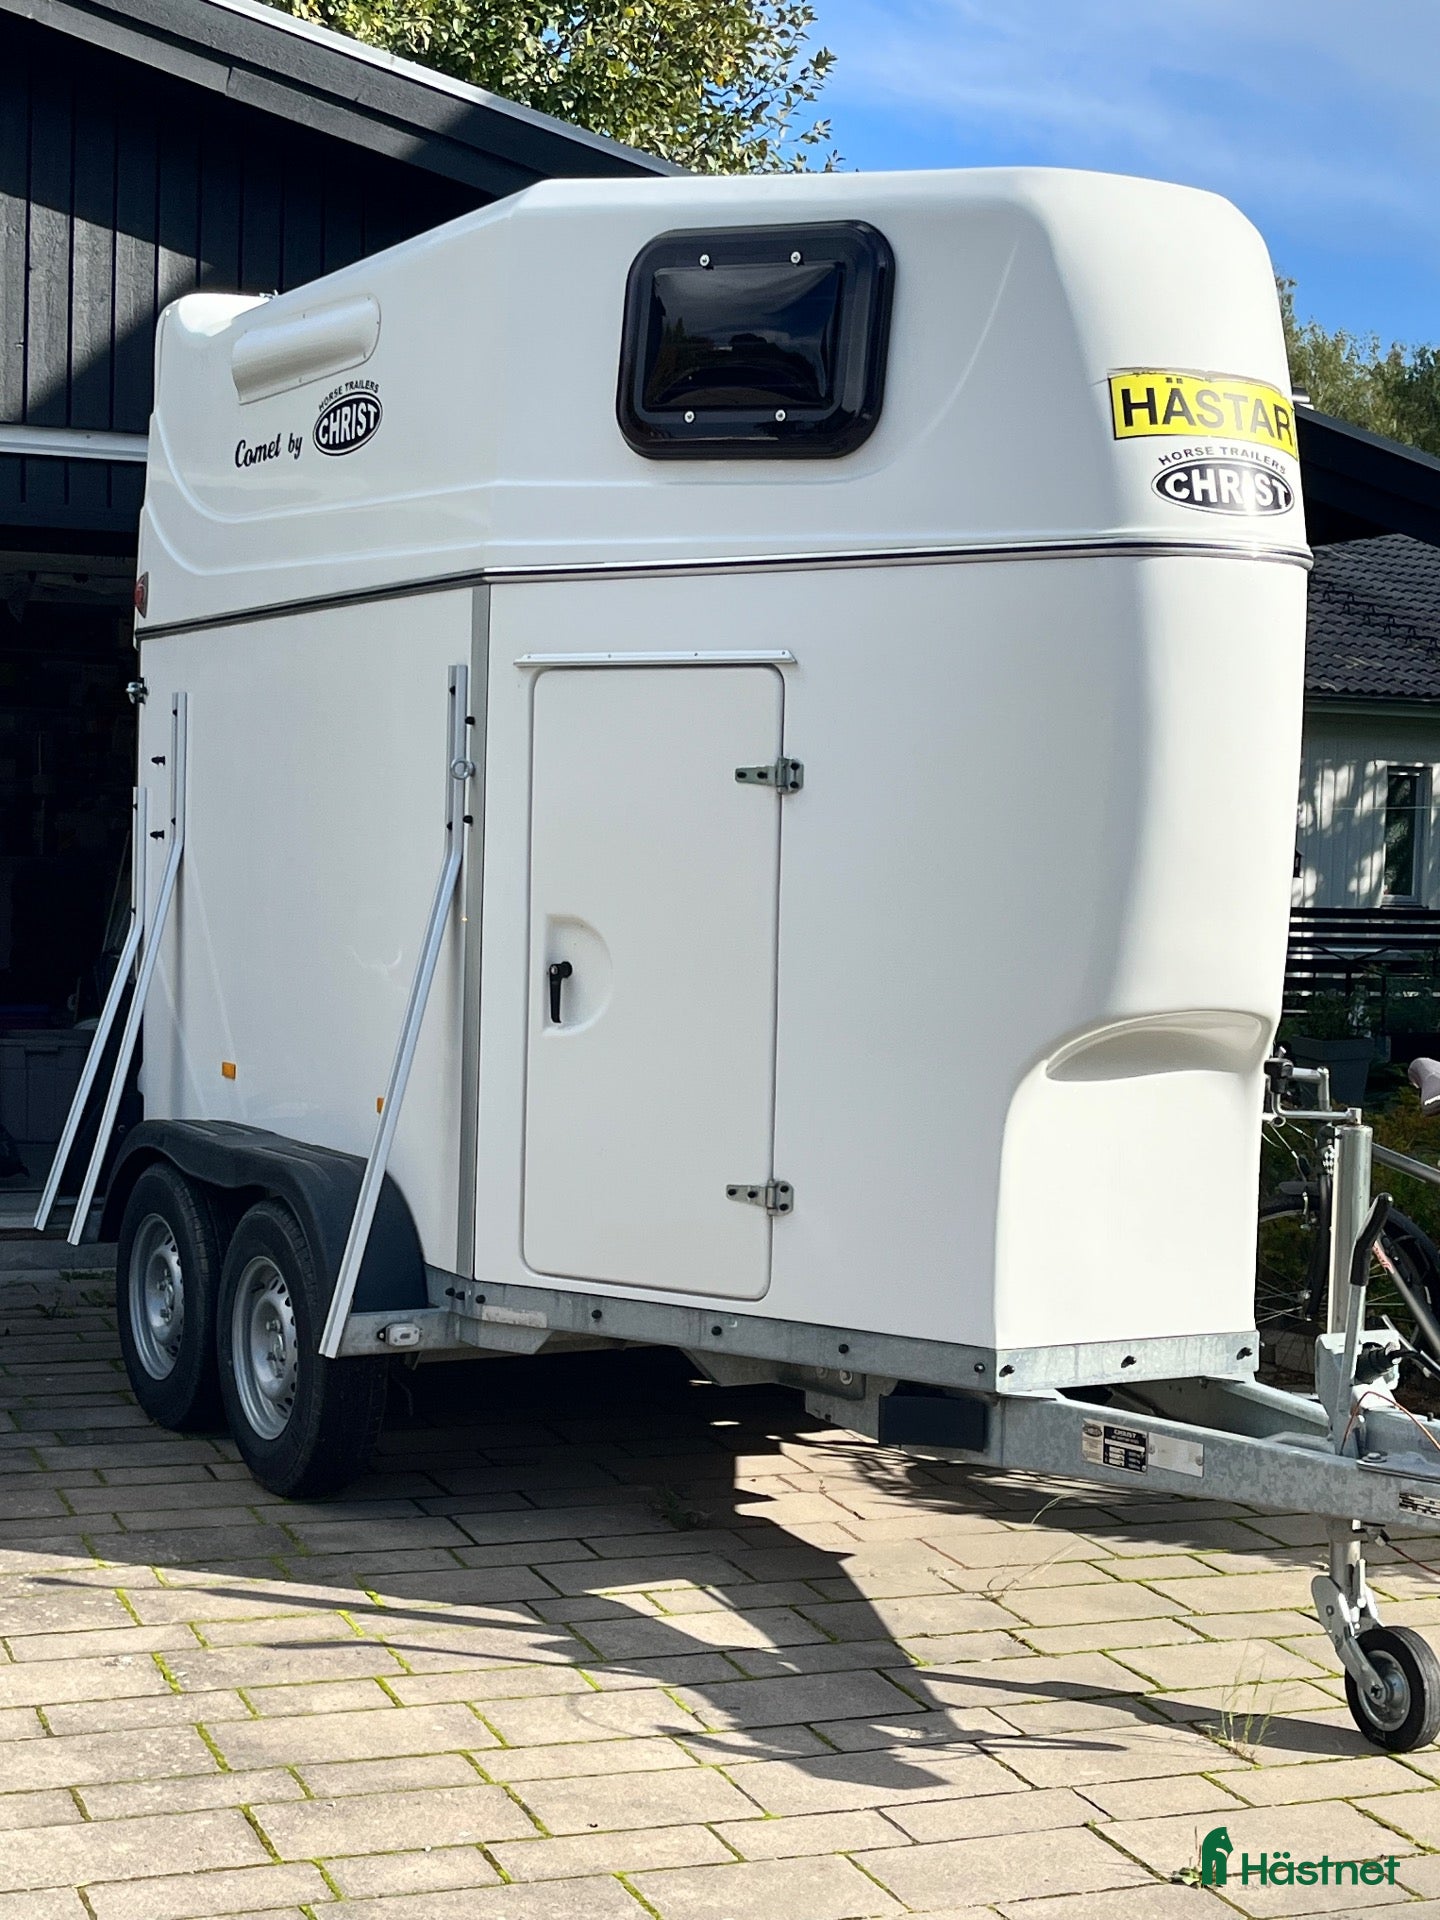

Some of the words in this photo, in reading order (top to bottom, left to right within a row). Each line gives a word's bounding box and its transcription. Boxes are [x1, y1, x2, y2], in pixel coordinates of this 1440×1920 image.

[318, 386, 343, 412] HORSE
[344, 379, 380, 394] TRAILERS
[1121, 377, 1294, 447] HÄSTAR
[318, 401, 378, 445] CHRIST
[235, 432, 282, 468] Comet
[287, 432, 303, 460] by
[1158, 446, 1215, 467] HORSE
[1219, 446, 1287, 475] TRAILERS
[1164, 468, 1289, 508] CHRIST
